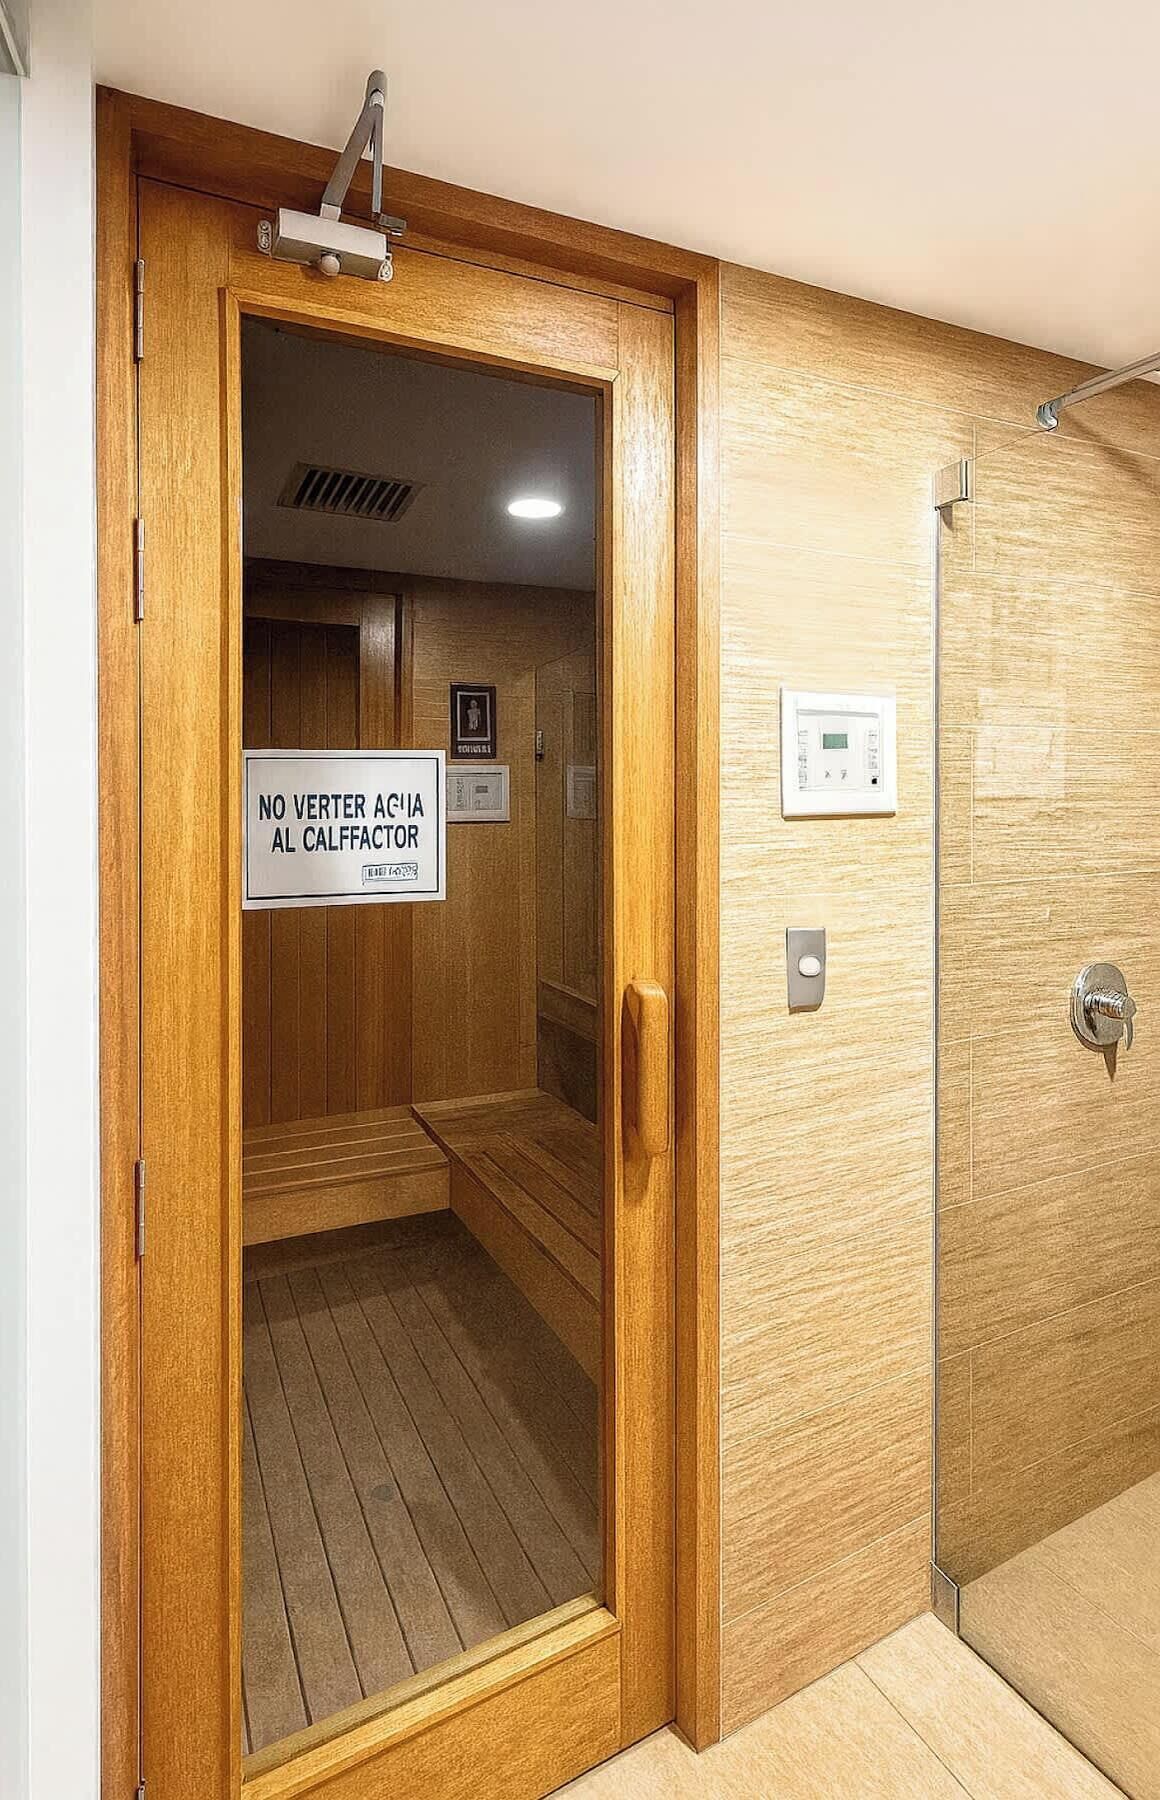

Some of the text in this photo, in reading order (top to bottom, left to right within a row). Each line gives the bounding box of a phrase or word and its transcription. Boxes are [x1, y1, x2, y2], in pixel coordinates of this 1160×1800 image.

[258, 794, 286, 820] NO
[294, 793, 366, 820] VERTER
[271, 827, 297, 853] AL
